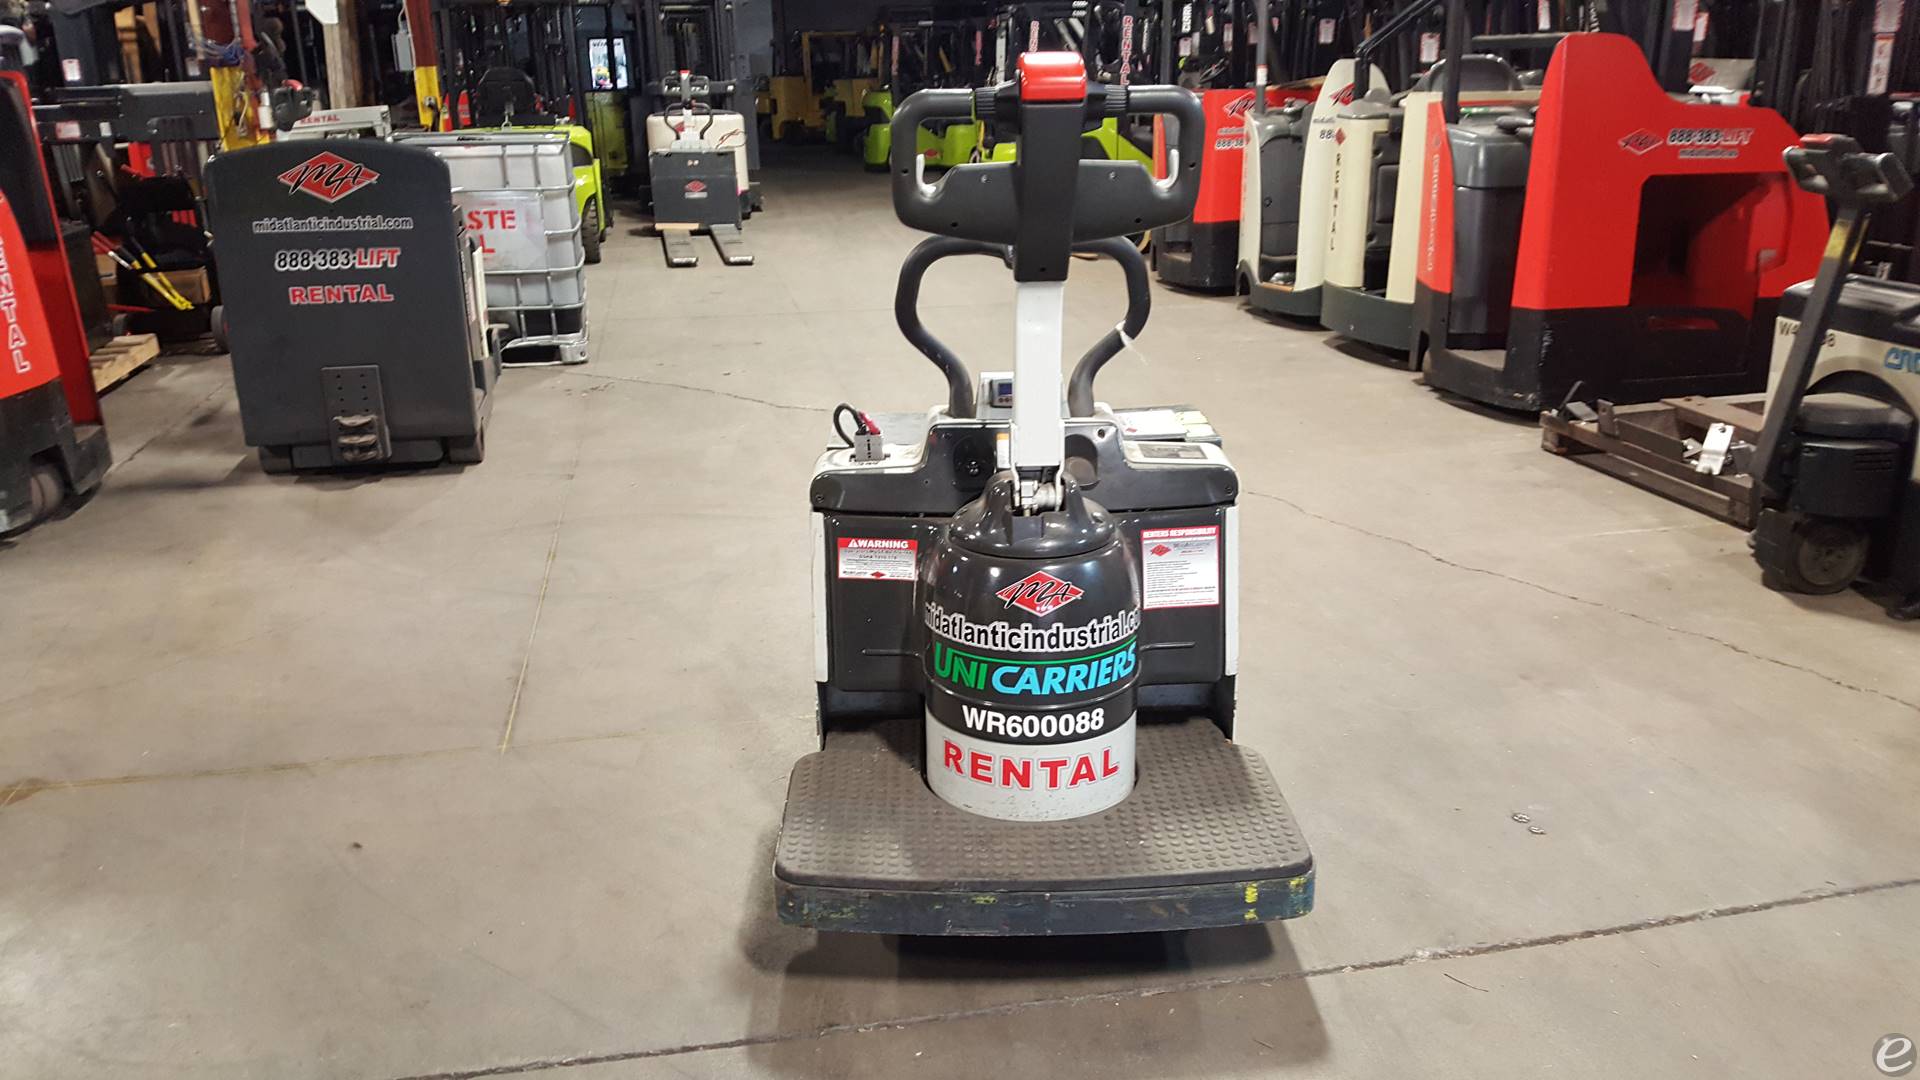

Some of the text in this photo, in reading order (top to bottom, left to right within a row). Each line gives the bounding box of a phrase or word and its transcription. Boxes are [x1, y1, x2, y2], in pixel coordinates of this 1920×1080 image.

[1120, 15, 1134, 85] RENTAL
[253, 215, 414, 234] midatlanticindustrial.com
[288, 284, 395, 304] RENTAL
[857, 539, 909, 549] WARNING
[962, 704, 1105, 737] WR600088
[943, 739, 1120, 789] RENTAL
